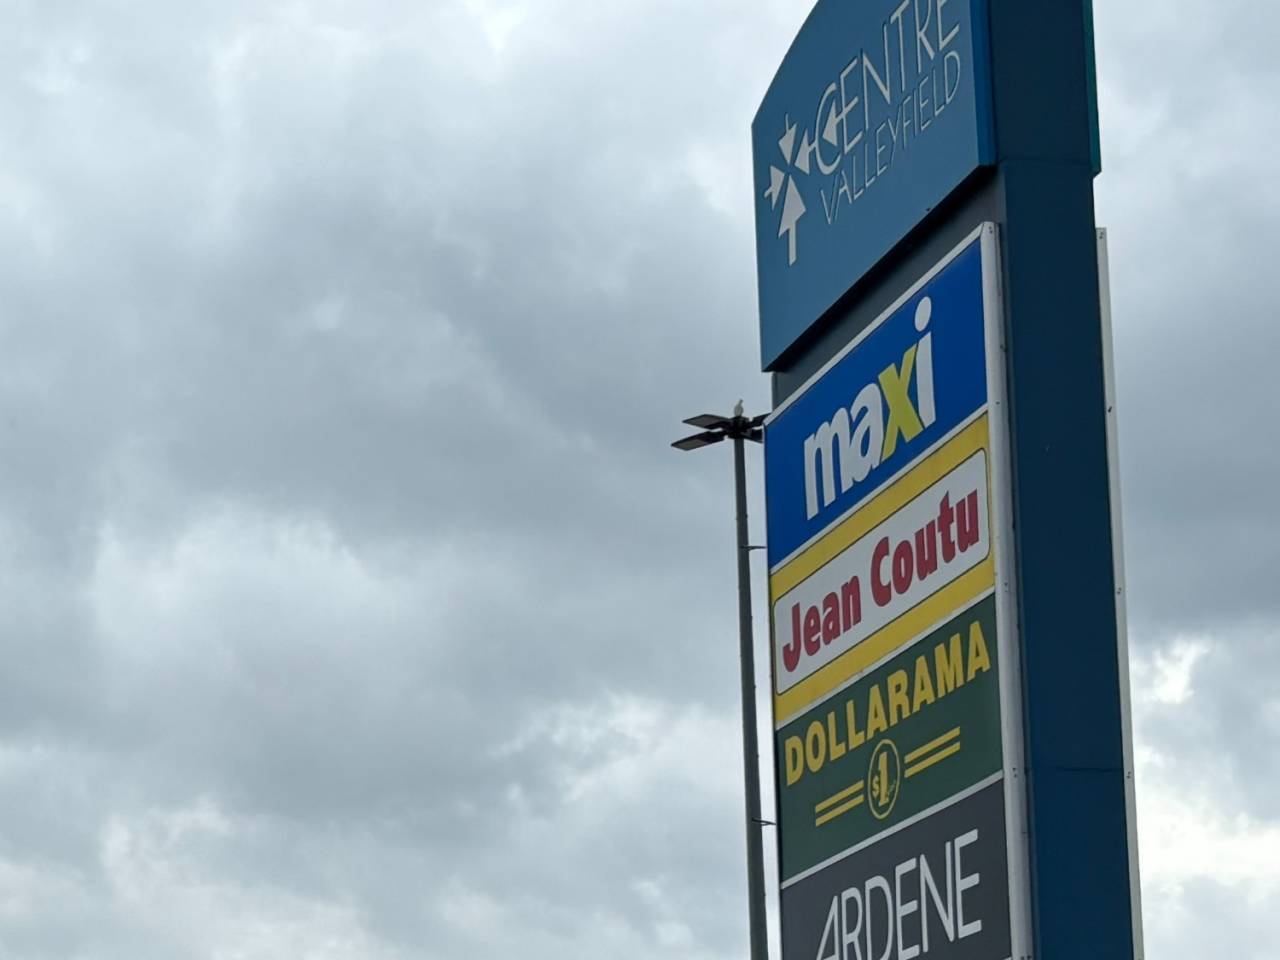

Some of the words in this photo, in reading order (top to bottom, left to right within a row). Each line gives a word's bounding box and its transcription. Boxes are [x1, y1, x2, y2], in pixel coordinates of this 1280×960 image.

[814, 0, 960, 175] CENTRE
[820, 50, 961, 225] VALLEYFIELD
[803, 296, 937, 521] maxi
[782, 574, 862, 673] Jean
[870, 490, 980, 608] Coutu
[784, 620, 991, 787] DOLLARAMA
